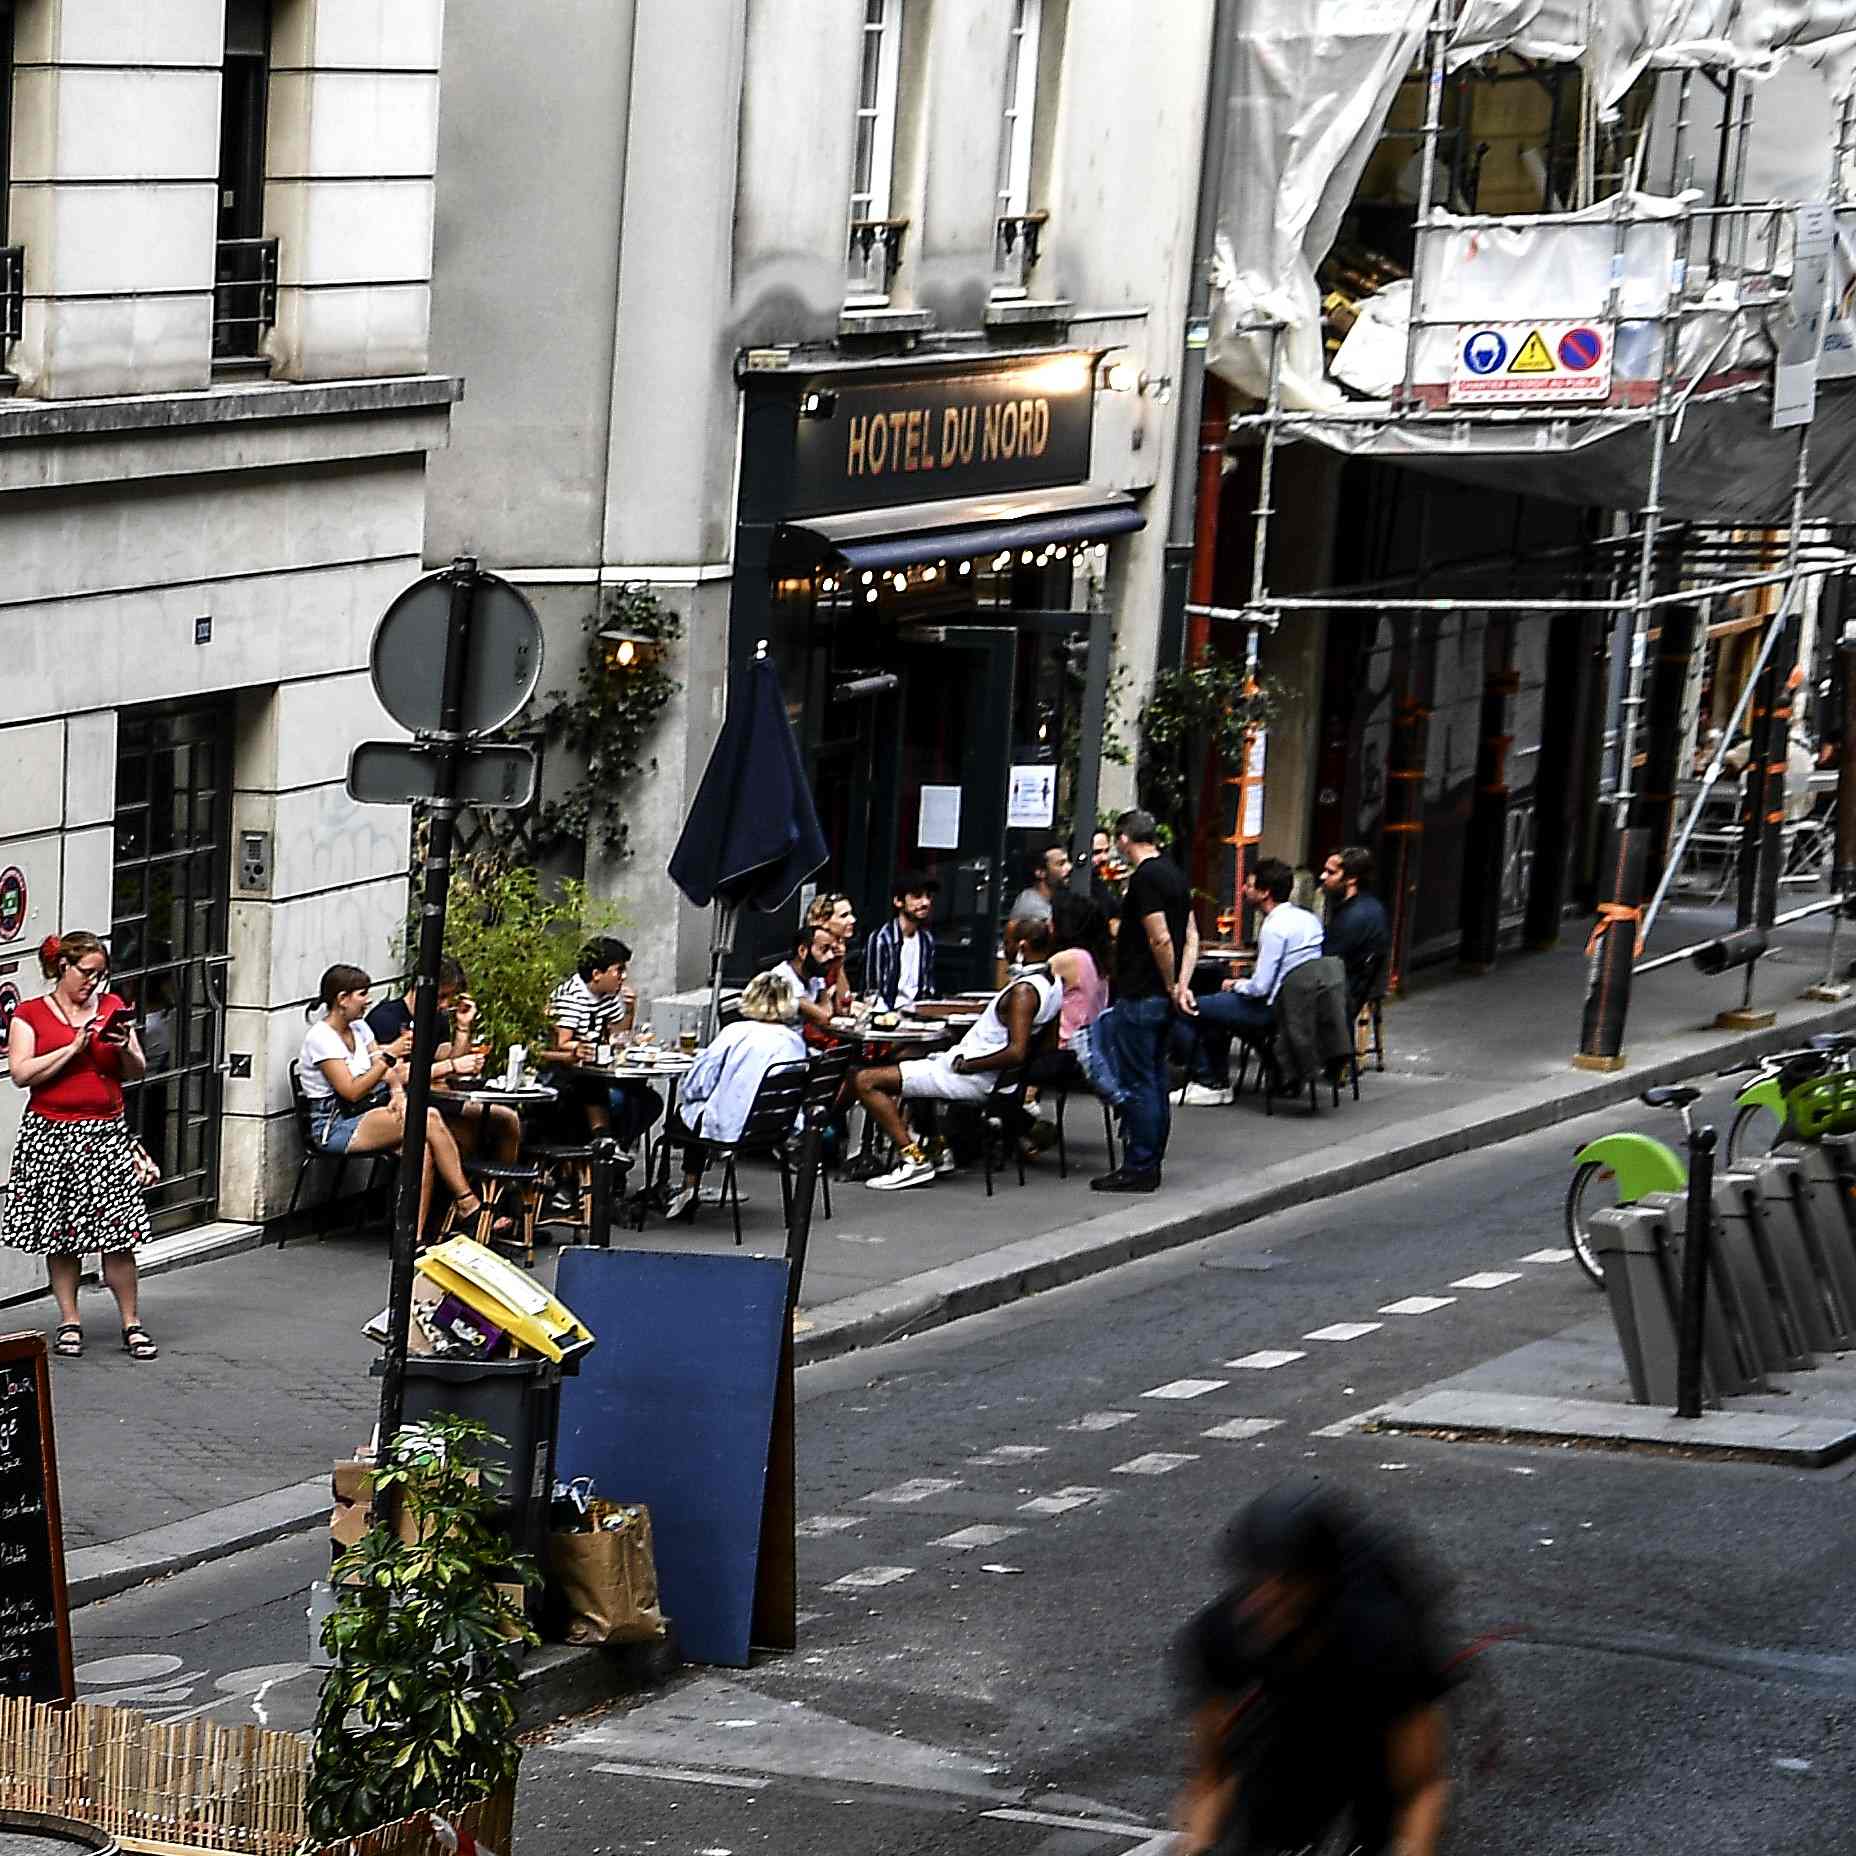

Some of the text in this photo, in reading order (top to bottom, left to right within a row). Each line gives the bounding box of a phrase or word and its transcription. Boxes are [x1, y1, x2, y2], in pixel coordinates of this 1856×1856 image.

[848, 398, 1050, 477] HOTEL DU NORD
